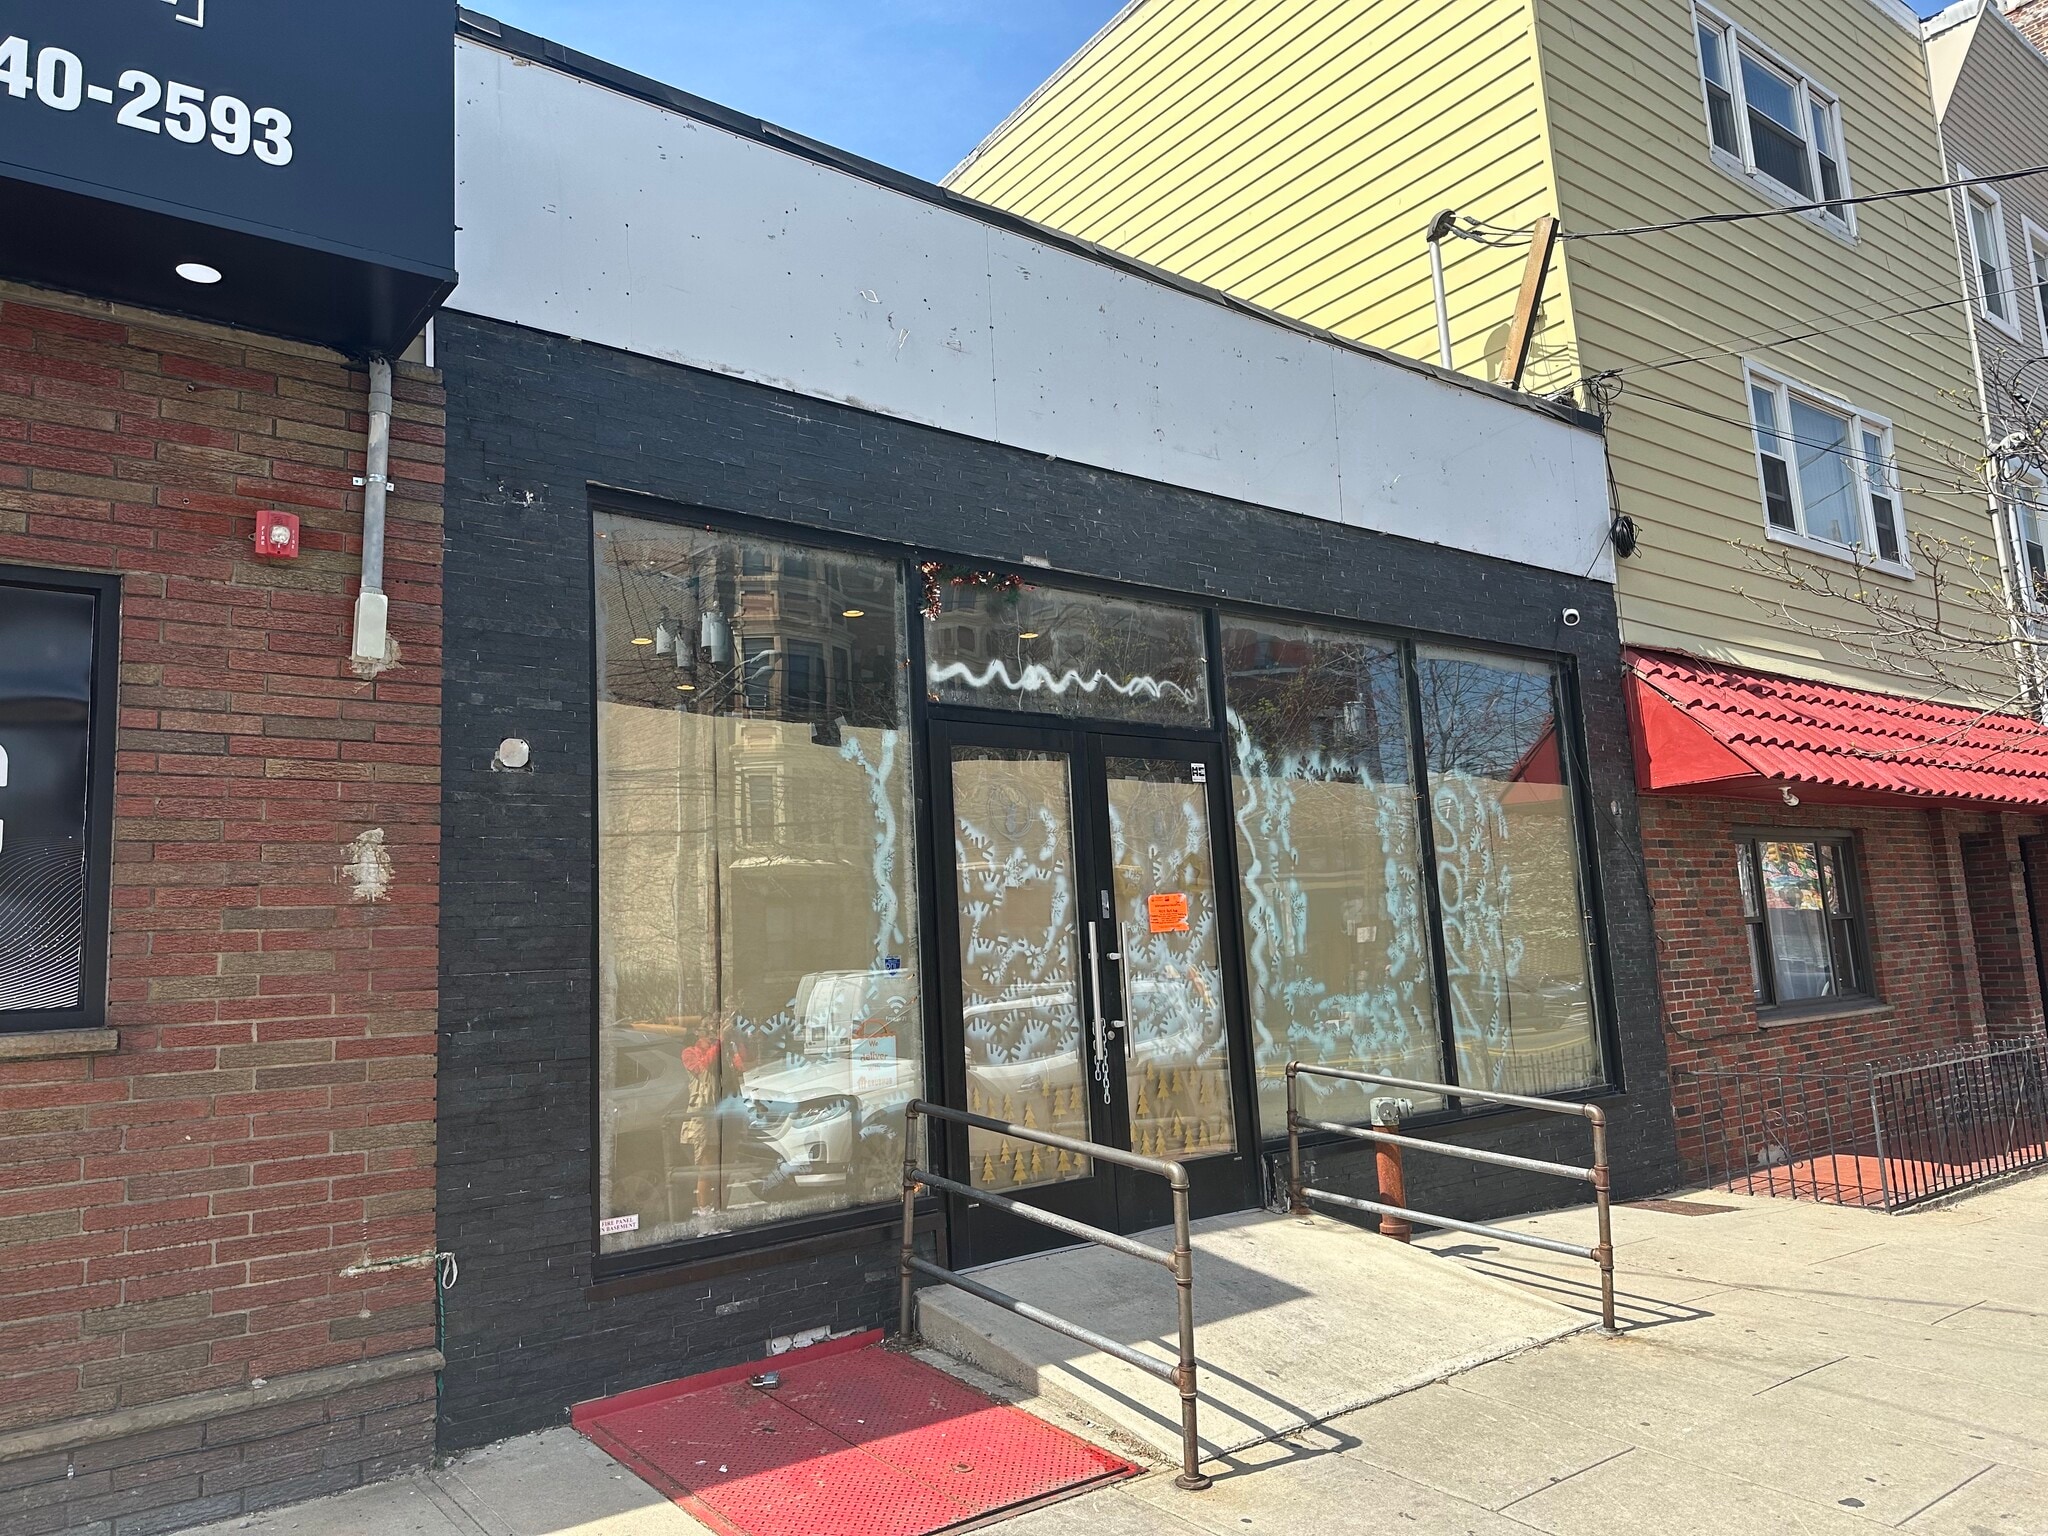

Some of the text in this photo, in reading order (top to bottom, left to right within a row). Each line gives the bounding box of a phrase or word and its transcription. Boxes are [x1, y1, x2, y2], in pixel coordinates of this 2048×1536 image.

[0, 36, 293, 166] 40-2593
[860, 1051, 889, 1061] deliver
[616, 1217, 633, 1225] PANEL
[606, 1222, 636, 1232] BASEMENT
